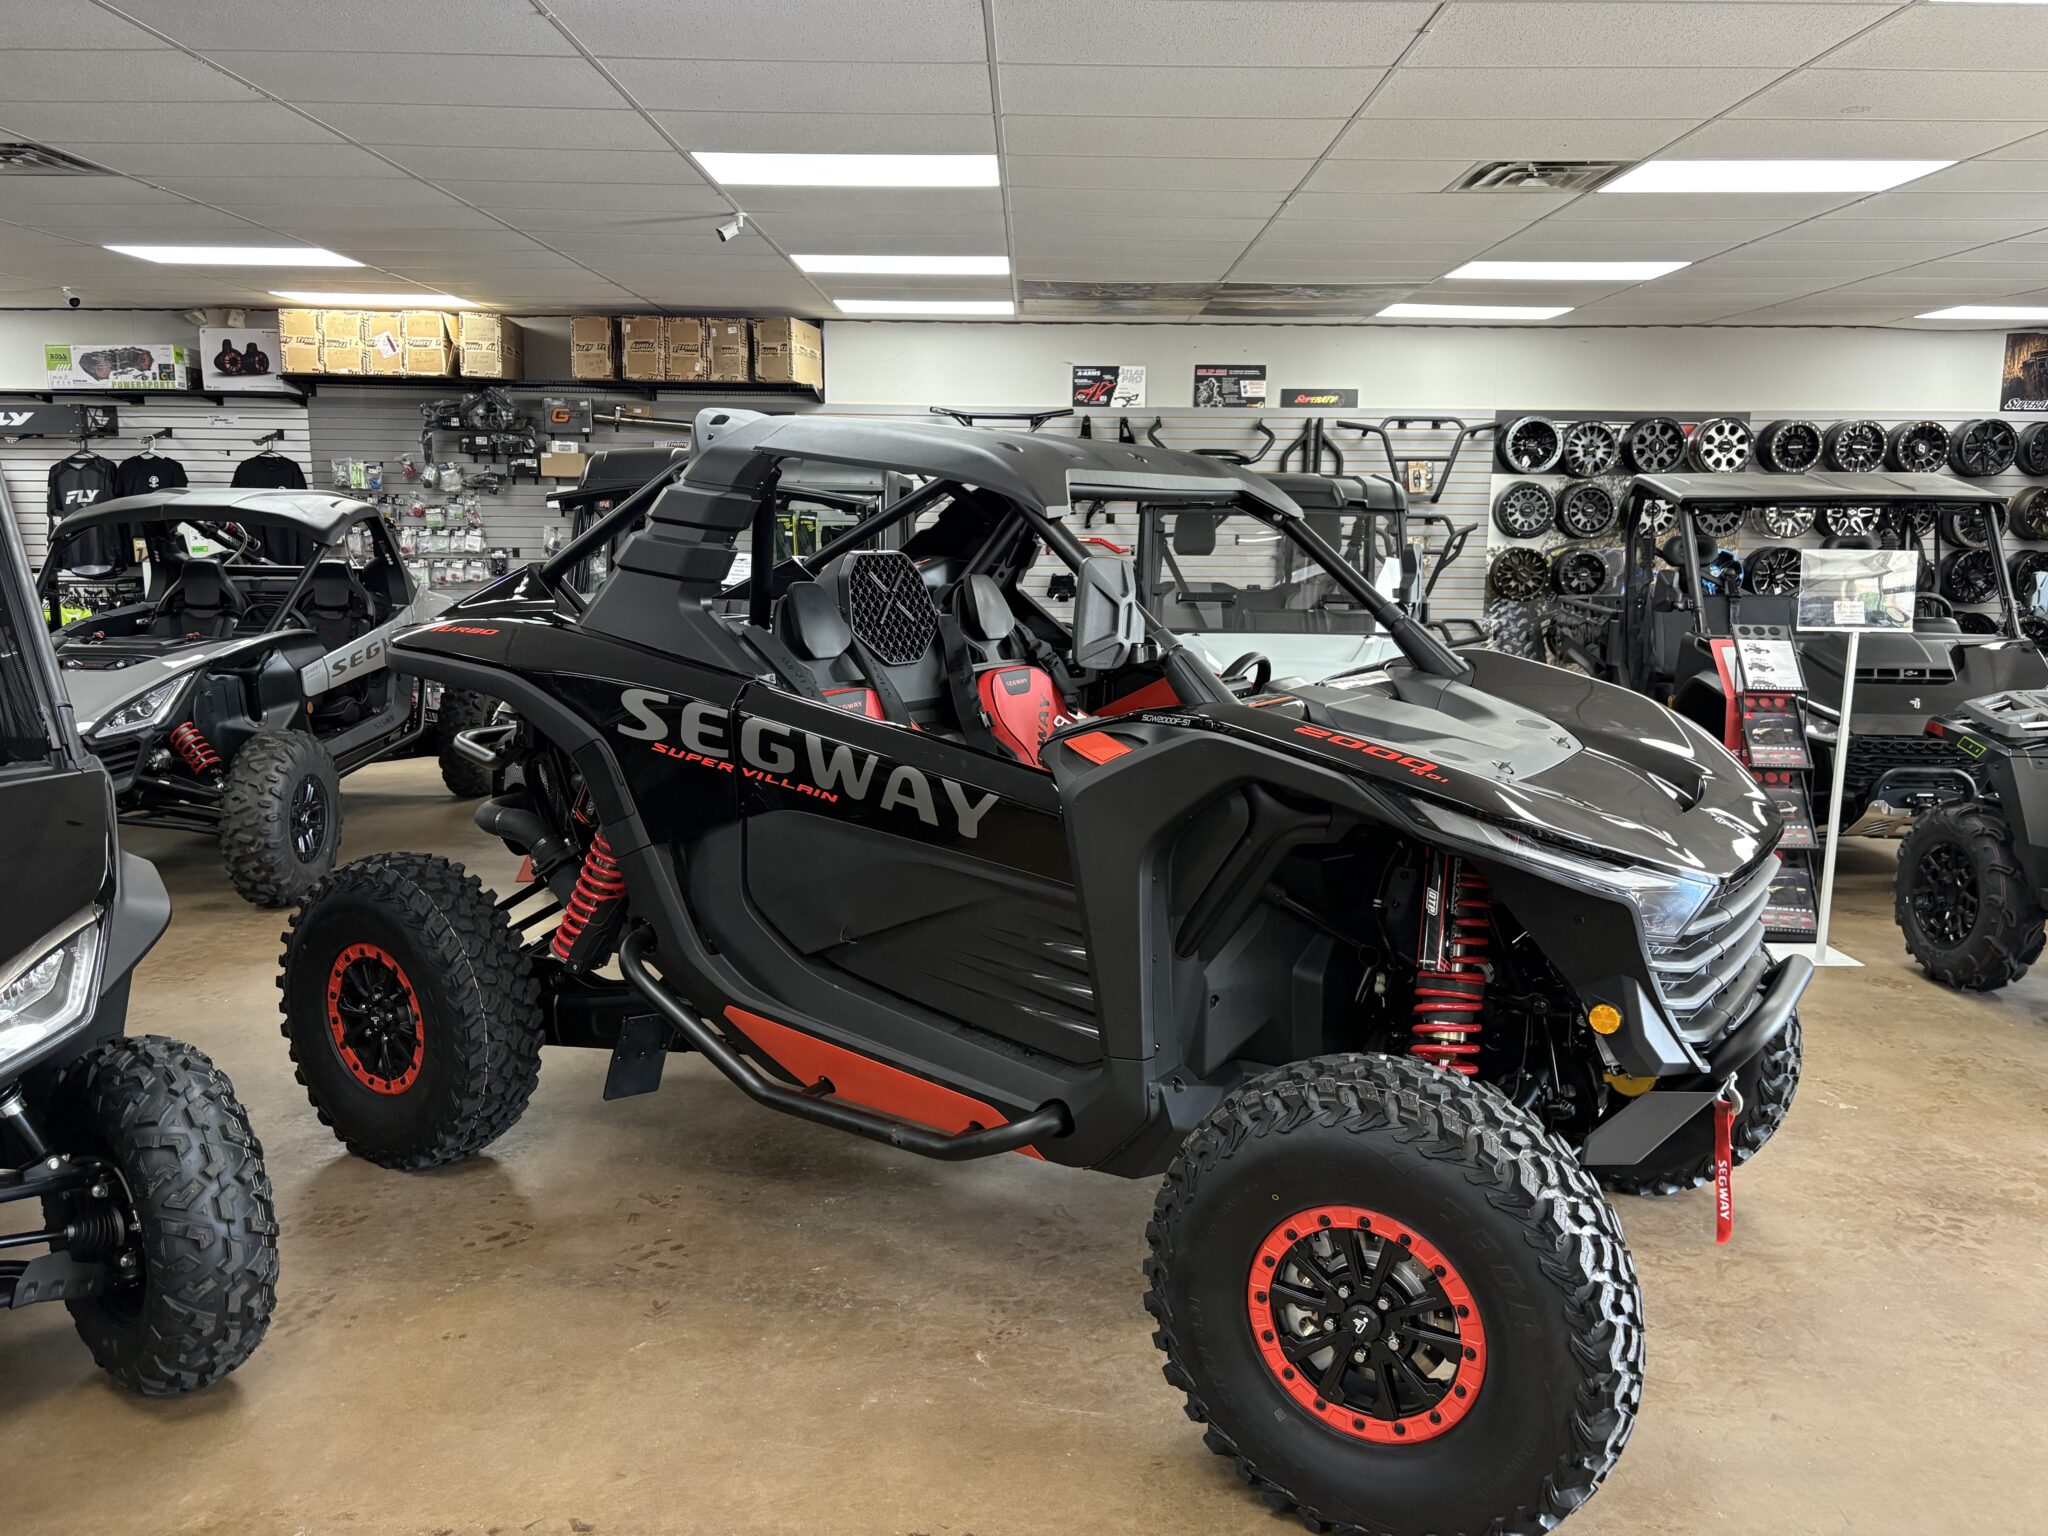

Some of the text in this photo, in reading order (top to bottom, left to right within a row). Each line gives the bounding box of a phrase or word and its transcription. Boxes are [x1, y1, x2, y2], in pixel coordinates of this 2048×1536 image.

[1120, 368, 1144, 376] ATLAS
[112, 381, 177, 389] POWERSPORTS
[1121, 376, 1143, 384] PRO
[2004, 397, 2048, 410] SUPERA
[0, 411, 35, 427] LY
[65, 489, 101, 505] FLY
[1005, 678, 1028, 687] SEGWAY
[1141, 714, 1191, 727] SGW2000F-S1
[1294, 725, 1438, 772] 2000
[617, 687, 1000, 839] SEGWAY
[651, 742, 839, 803] SUPER VILLAIN
[1717, 1159, 1731, 1221] SEGWAY
